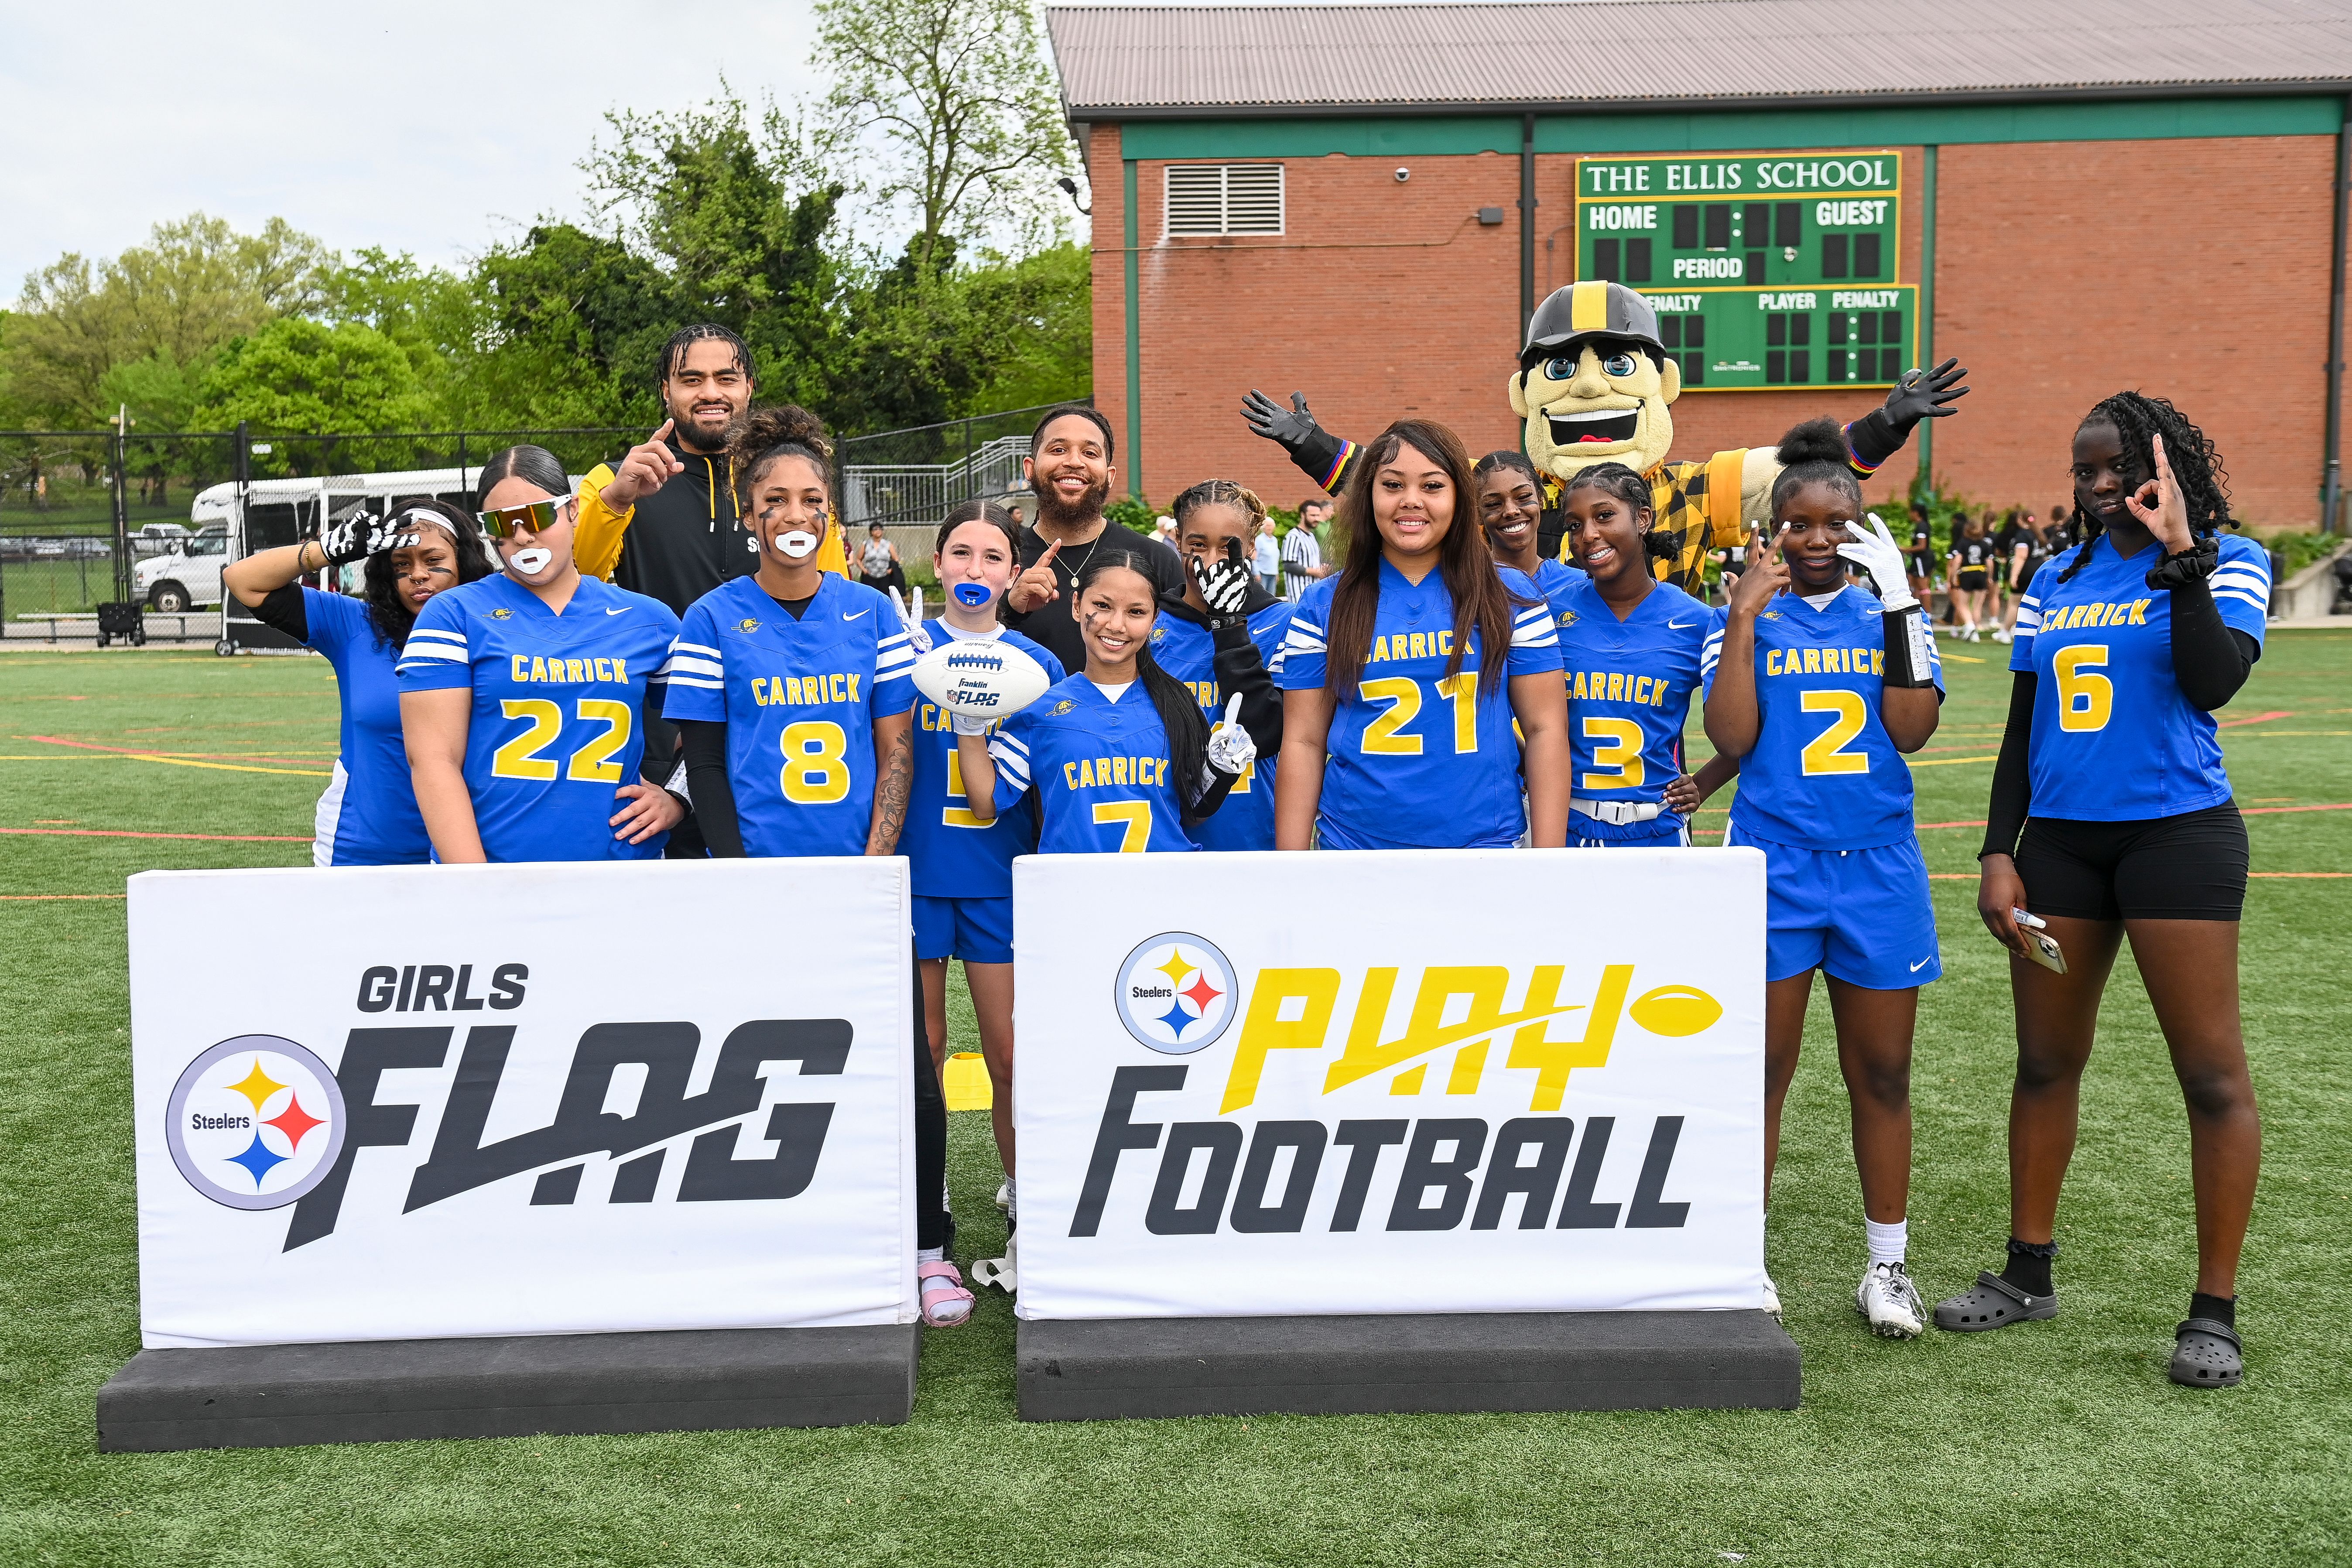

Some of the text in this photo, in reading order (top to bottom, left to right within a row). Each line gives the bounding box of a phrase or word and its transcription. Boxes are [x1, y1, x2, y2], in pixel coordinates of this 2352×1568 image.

[1586, 160, 1890, 192] THE ELLIS SCHOOL
[1589, 205, 1657, 230] HOME
[1816, 200, 1888, 226] GUEST
[1673, 257, 1743, 279] PERIOD
[1758, 292, 1817, 310] PLAYER
[1832, 290, 1900, 309] PENALTY
[2038, 599, 2152, 634] CARRICK
[511, 654, 629, 685] CARRICK
[1767, 648, 1884, 677] CARRICK
[751, 673, 861, 706] CARRICK
[955, 691, 1000, 706] FLAG
[2053, 644, 2113, 733] 6
[1358, 671, 1479, 755] 21
[491, 698, 632, 784] 22
[1800, 689, 1870, 776] 2
[780, 721, 850, 805] 8
[1582, 717, 1645, 790] 3
[1063, 757, 1169, 791] CARRICK
[1092, 800, 1153, 852] 7
[357, 963, 529, 1013] GIRLS
[1133, 986, 1172, 998] Steelers
[1218, 964, 1635, 1115] PLAY
[192, 1113, 250, 1130] Steelers
[282, 1018, 854, 1254] FLAG
[1068, 1065, 1691, 1237] FOOTBALL
